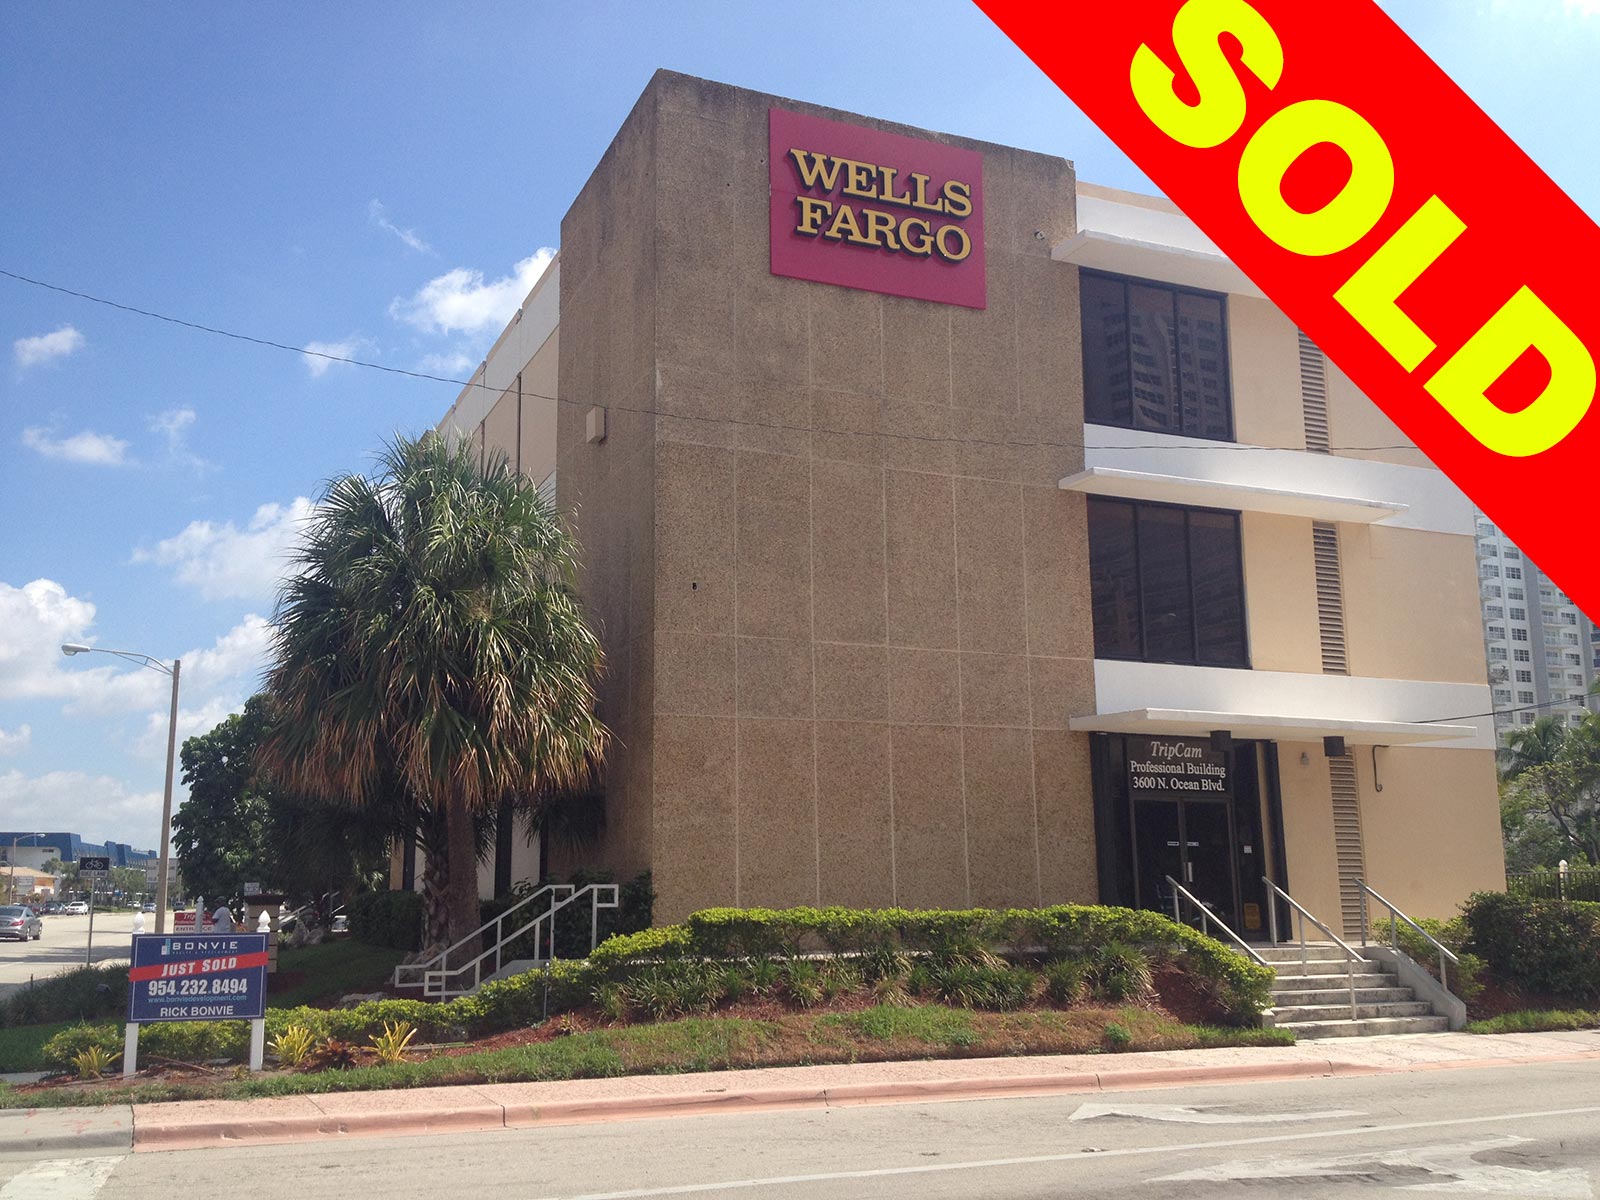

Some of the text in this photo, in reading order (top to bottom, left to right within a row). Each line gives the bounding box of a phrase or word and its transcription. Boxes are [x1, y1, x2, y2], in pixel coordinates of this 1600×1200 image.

[788, 147, 974, 219] WELLS
[795, 195, 973, 263] FARGO
[1150, 741, 1203, 760] TripCam
[1129, 760, 1226, 778] Professional Building
[1133, 776, 1225, 791] 3600 N. Ocean Blvd.
[172, 941, 238, 950] BONVIE
[161, 957, 237, 977] JUST SOLD
[148, 978, 248, 996] 954.232.8494
[160, 1005, 234, 1017] RICK BONVIE
